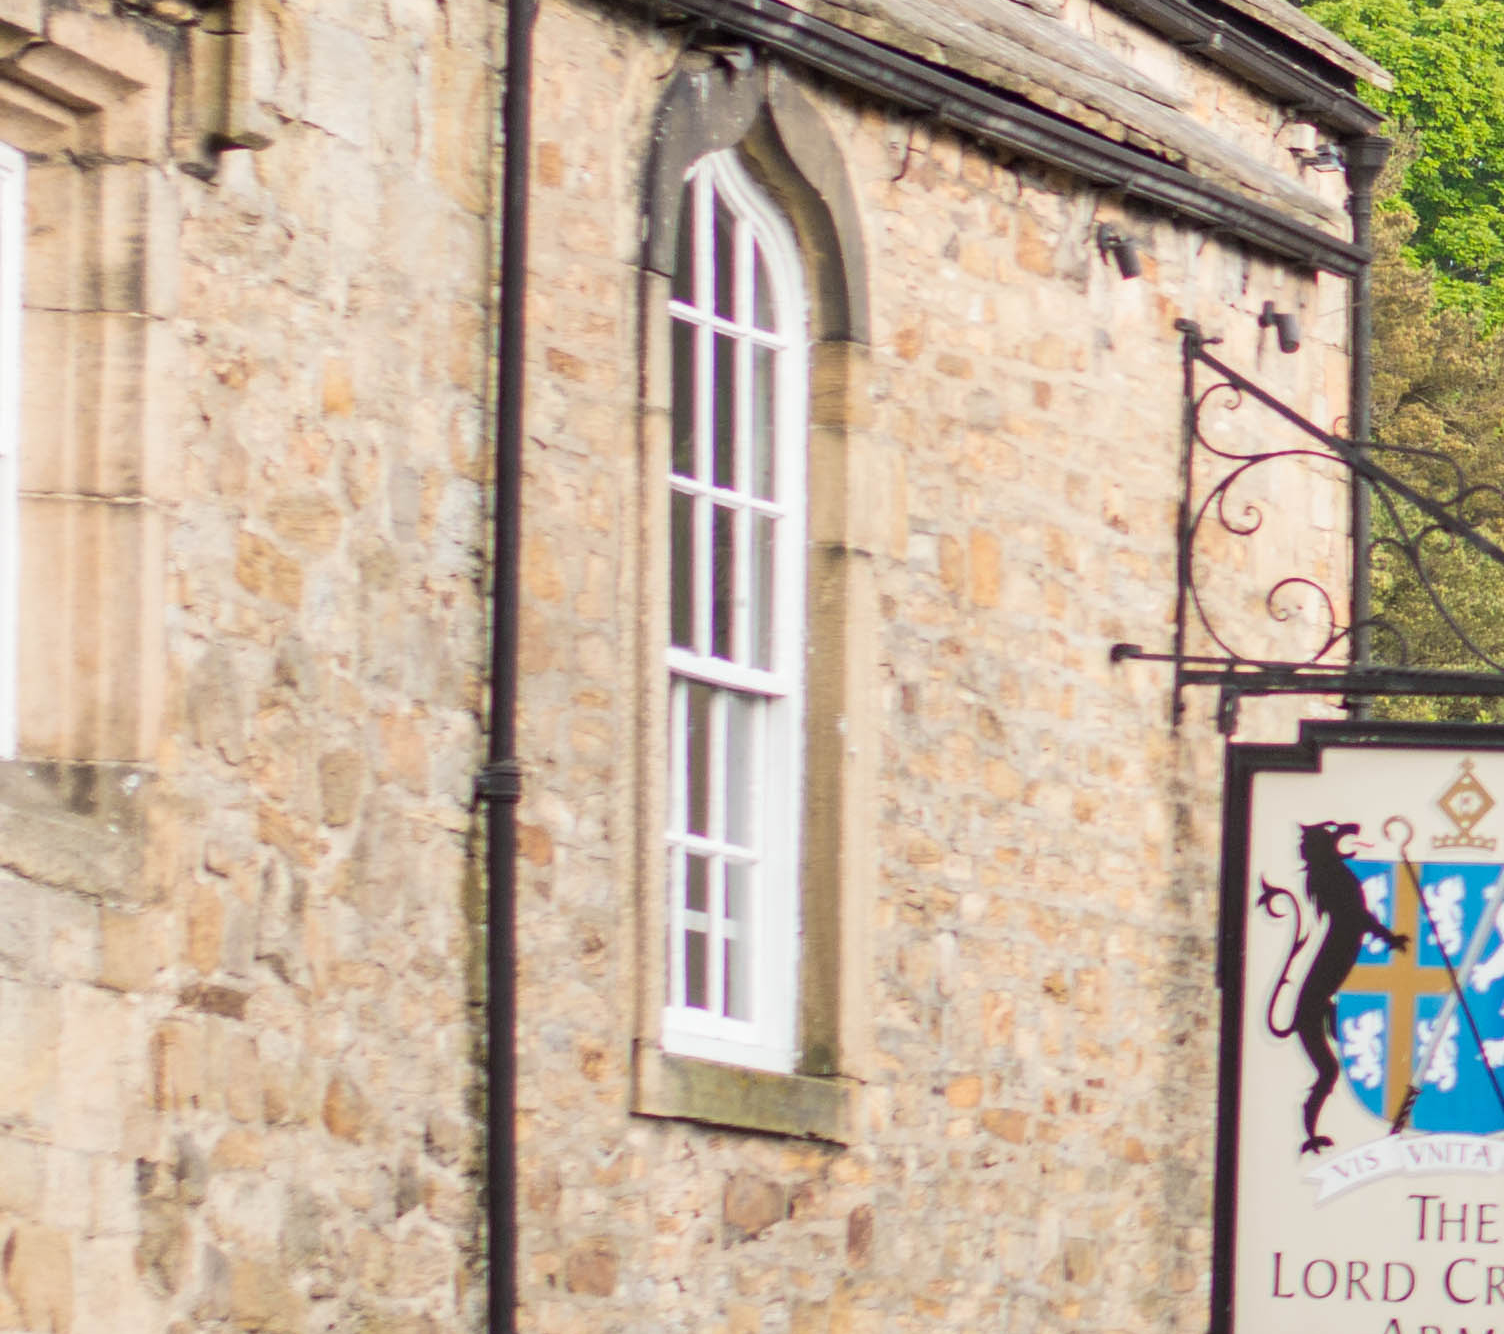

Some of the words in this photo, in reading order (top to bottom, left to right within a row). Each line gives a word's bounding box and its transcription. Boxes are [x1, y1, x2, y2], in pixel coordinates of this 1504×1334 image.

[1331, 1151, 1381, 1180] VIS
[1407, 1144, 1492, 1167] VNITA
[1407, 1194, 1500, 1245] THE
[1271, 1251, 1417, 1304] LORD
